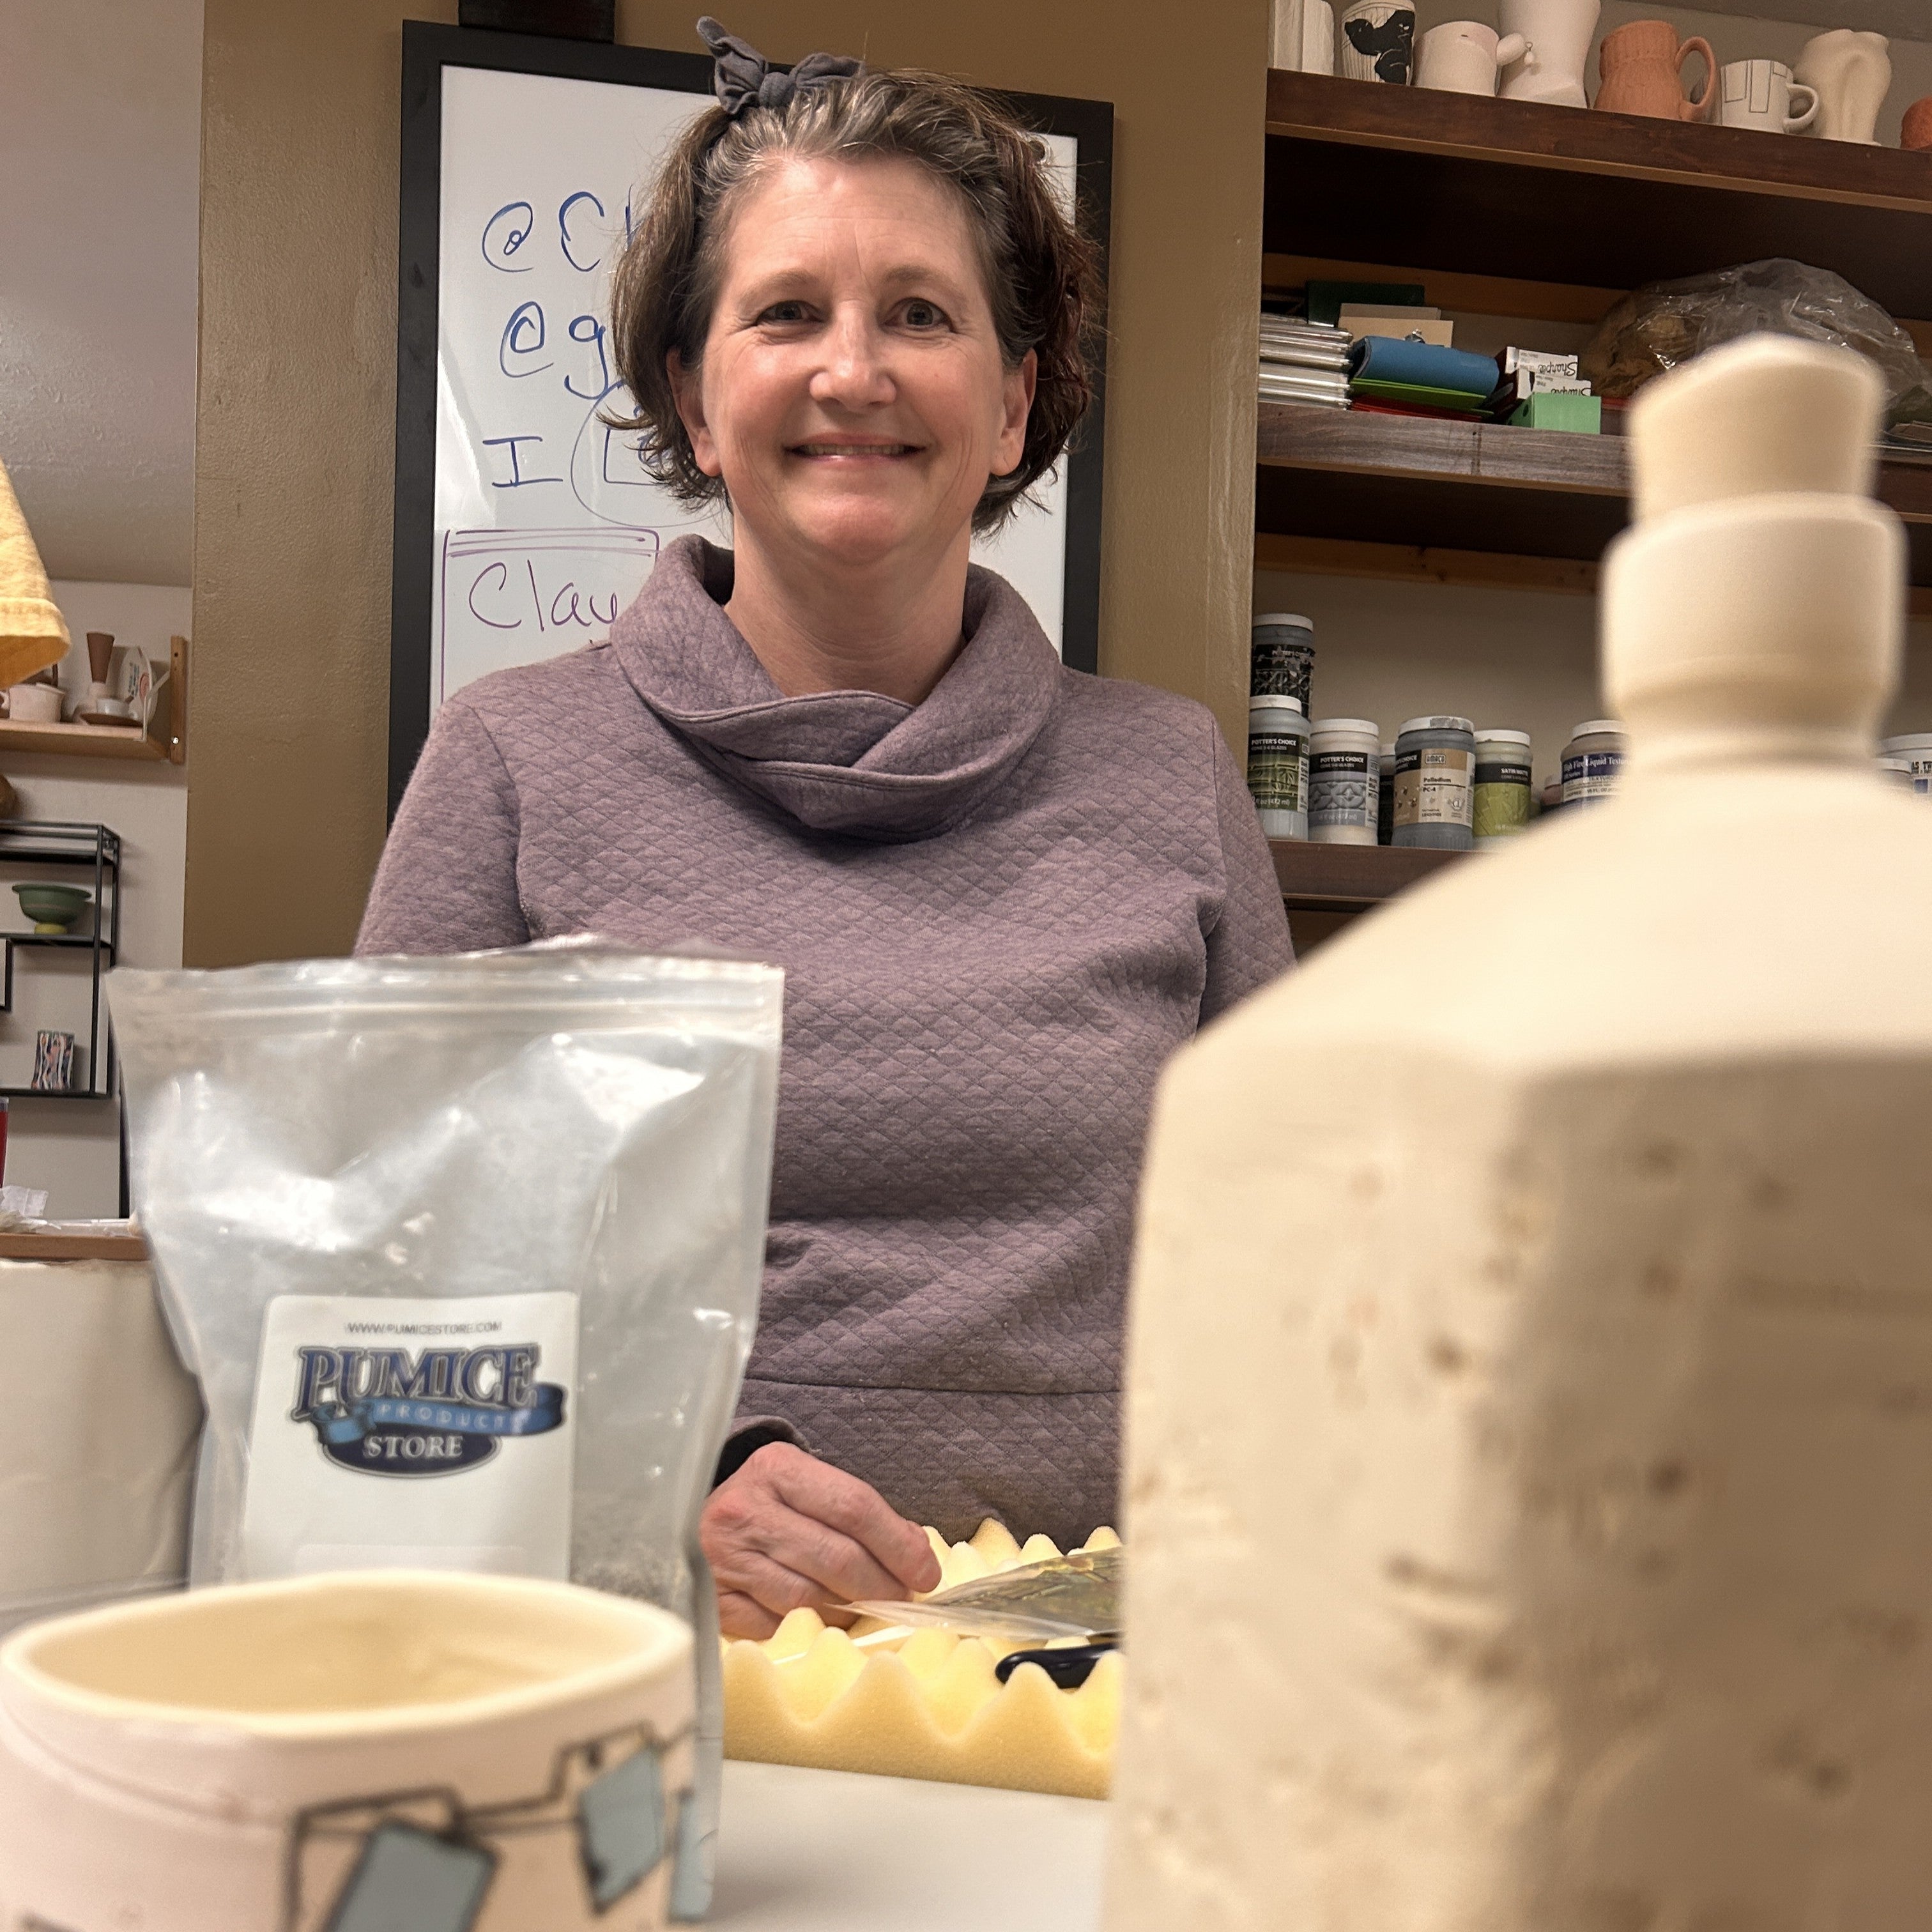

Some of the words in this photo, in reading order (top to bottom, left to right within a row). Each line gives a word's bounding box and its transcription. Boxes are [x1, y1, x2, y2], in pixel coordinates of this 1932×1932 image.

[1538, 362, 1578, 376] Sharpie
[1585, 757, 1606, 767] Liquid
[345, 1321, 502, 1336] WWW.PUMICESTORE.COM
[291, 1342, 542, 1422] PUMICE
[377, 1403, 532, 1431] PRODUCT
[364, 1435, 463, 1459] STORE
